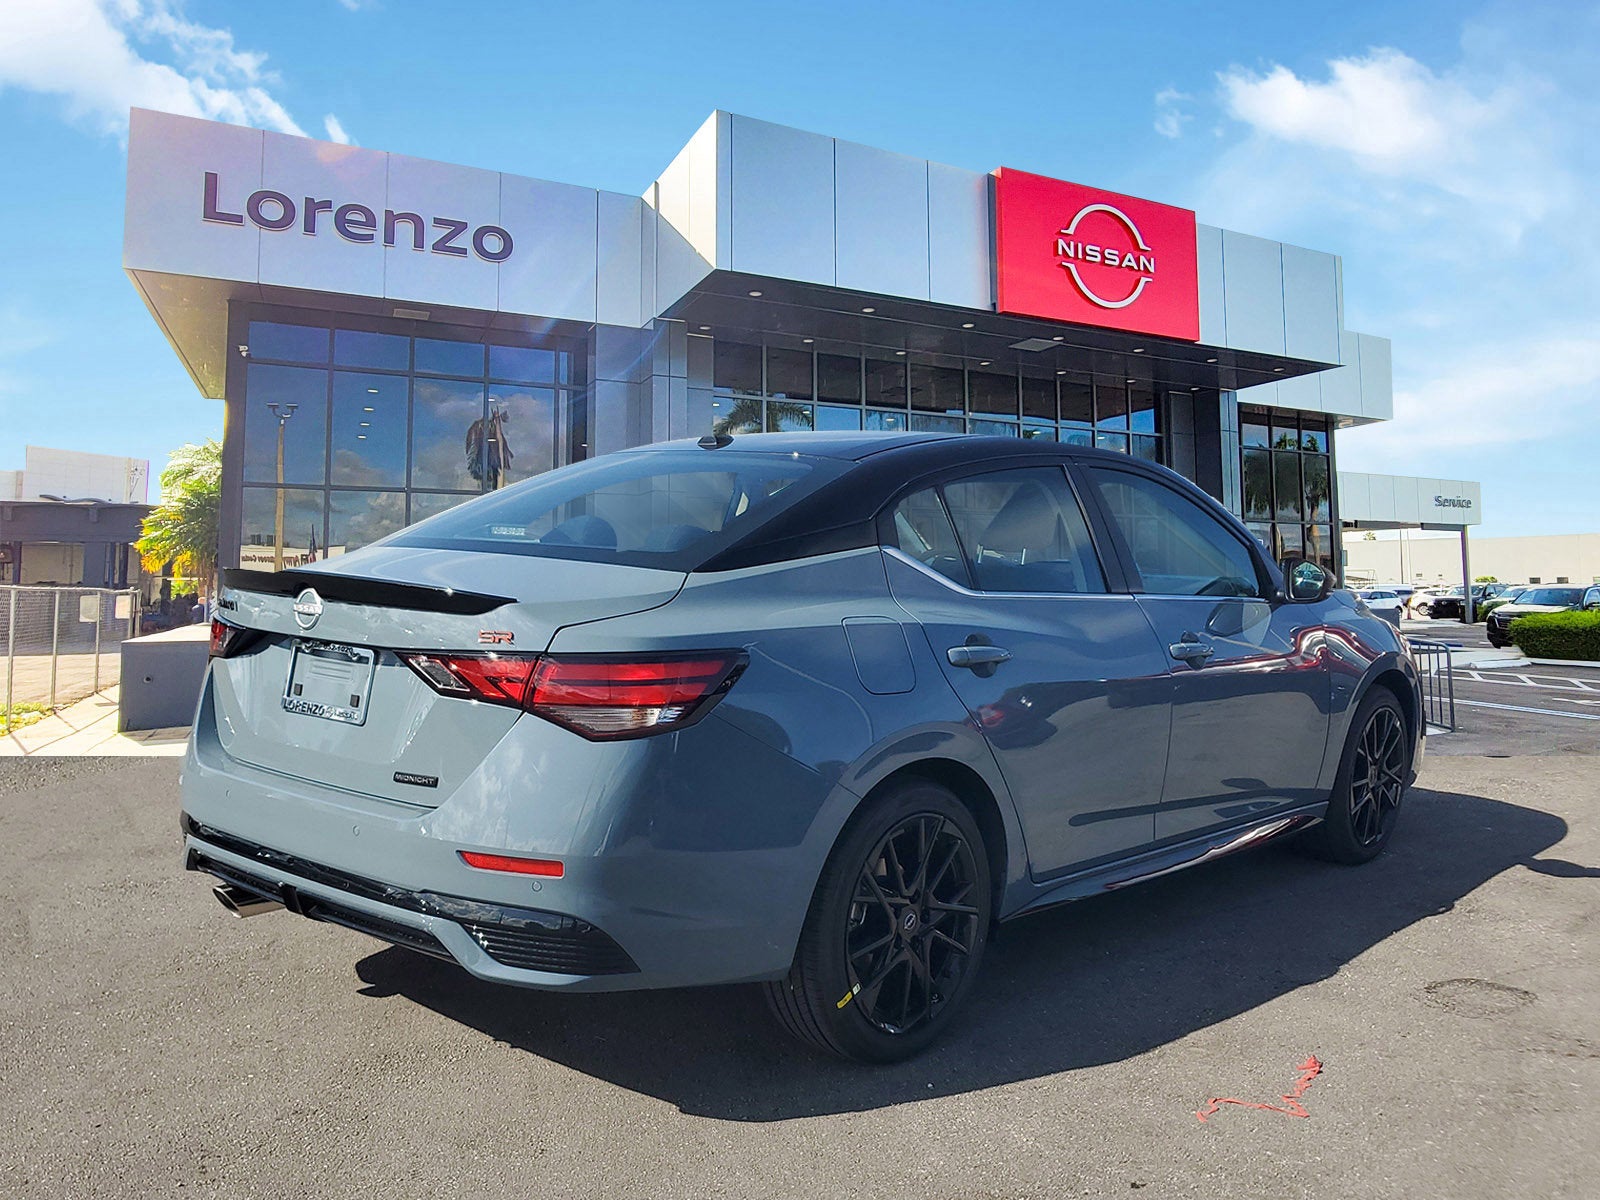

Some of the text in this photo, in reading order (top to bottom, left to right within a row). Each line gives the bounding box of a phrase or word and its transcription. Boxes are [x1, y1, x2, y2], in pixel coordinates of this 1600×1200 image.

[203, 171, 514, 262] Lorenzo
[1057, 238, 1155, 273] NISSAN
[1434, 495, 1472, 509] Service
[478, 629, 515, 646] SR
[282, 698, 326, 716] LORENZO
[395, 773, 435, 785] MIDNIGHT
